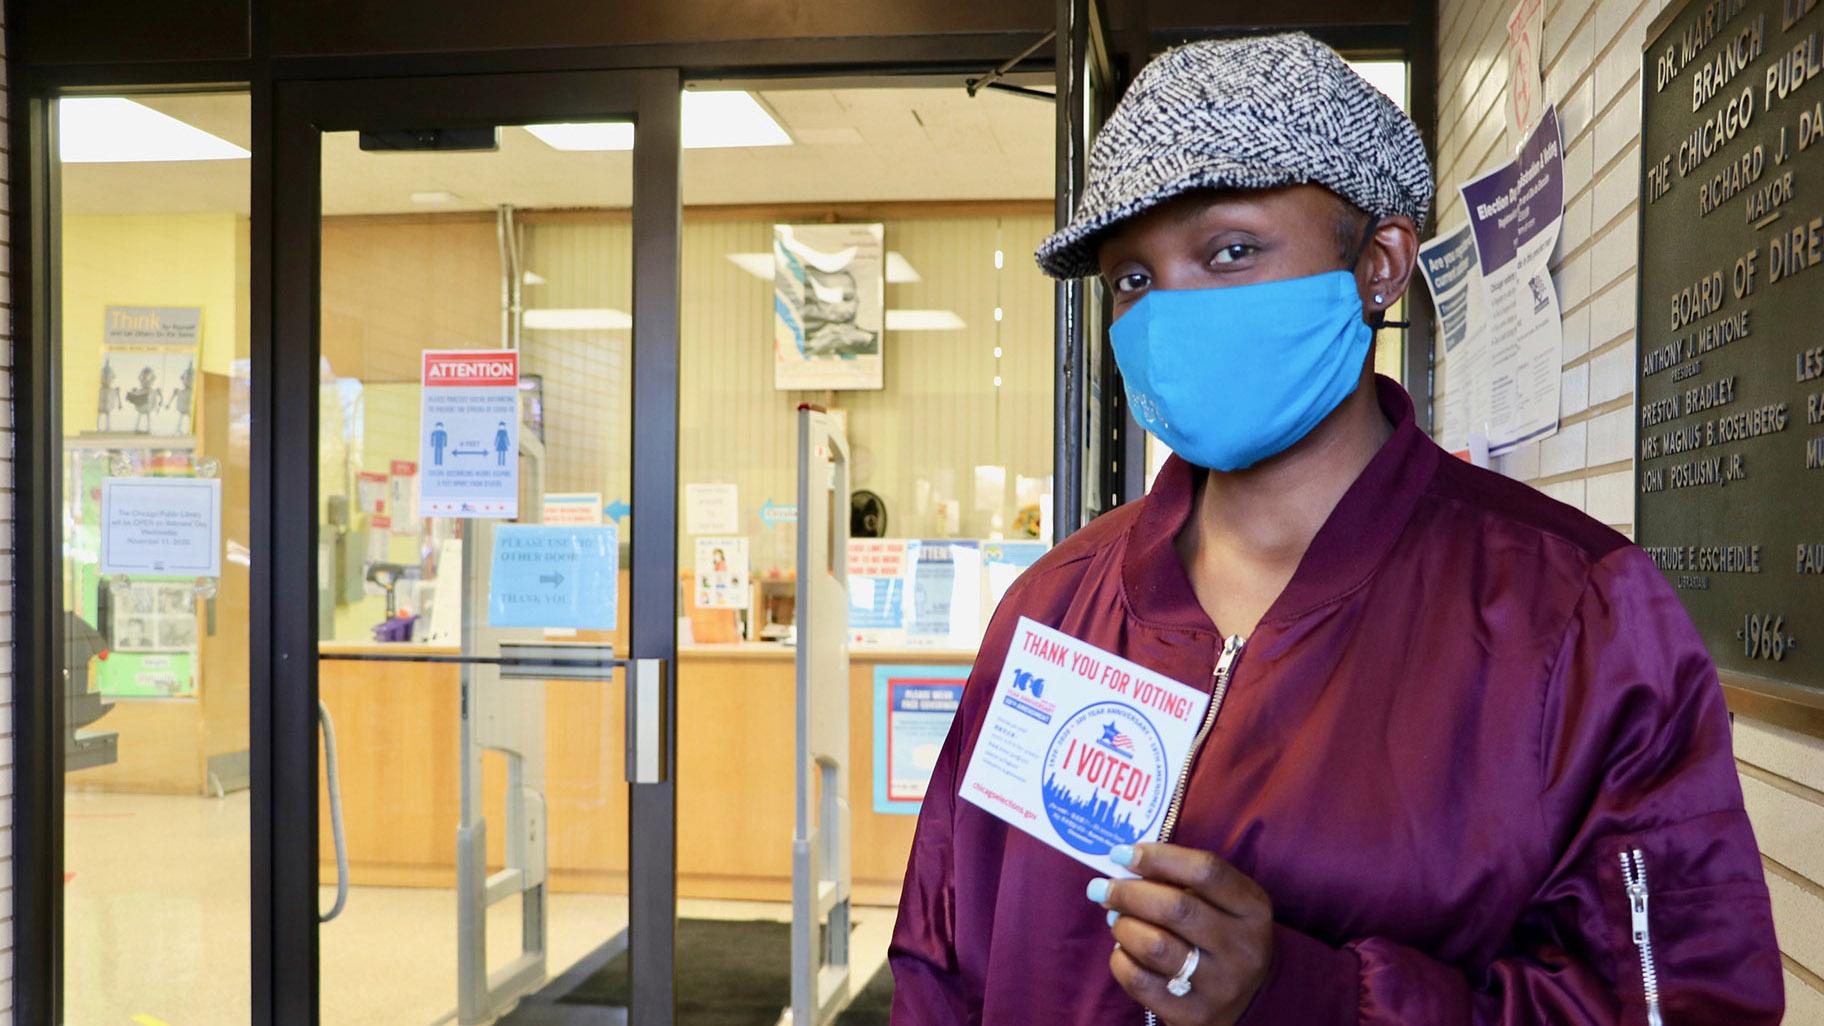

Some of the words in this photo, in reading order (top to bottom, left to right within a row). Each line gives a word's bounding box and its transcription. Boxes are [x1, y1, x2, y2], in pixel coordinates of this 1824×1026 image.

[1657, 44, 1678, 93] DR.
[1692, 13, 1764, 113] BRANCH
[1647, 154, 1672, 204] THE
[1679, 86, 1753, 178] CHICAGO
[1700, 144, 1765, 217] RICHARD
[1774, 126, 1788, 166] J.
[1745, 171, 1793, 224] MAYOR
[1671, 269, 1724, 332] BOARD
[1733, 248, 1760, 299] OF
[1769, 216, 1824, 284] DIRE
[111, 309, 160, 331] Think
[1642, 338, 1685, 378] ANTHONY
[1698, 309, 1750, 355] MENTONE
[430, 361, 515, 378] ATTENTION
[1642, 395, 1681, 428] PRESTON
[1685, 376, 1737, 414] BRADLEY
[1663, 423, 1702, 456] MAGNUS
[1719, 402, 1788, 444] ROSENBERG
[1641, 466, 1664, 493] JOHN
[1726, 452, 1745, 481] JR.
[501, 537, 542, 549] PLEASE
[501, 551, 542, 562] OTHER
[1643, 546, 1684, 571] RTRUDE
[1700, 544, 1761, 573] GSCHEIDLE
[501, 593, 542, 603] THANK
[1022, 630, 1069, 667] THANK
[1071, 651, 1100, 680] YOU
[1100, 665, 1131, 695] FOR
[1132, 677, 1195, 722] VOTING!
[1106, 707, 1150, 736] ANNIVERSARY
[1062, 738, 1077, 770] I
[1076, 742, 1152, 806] VOTED!
